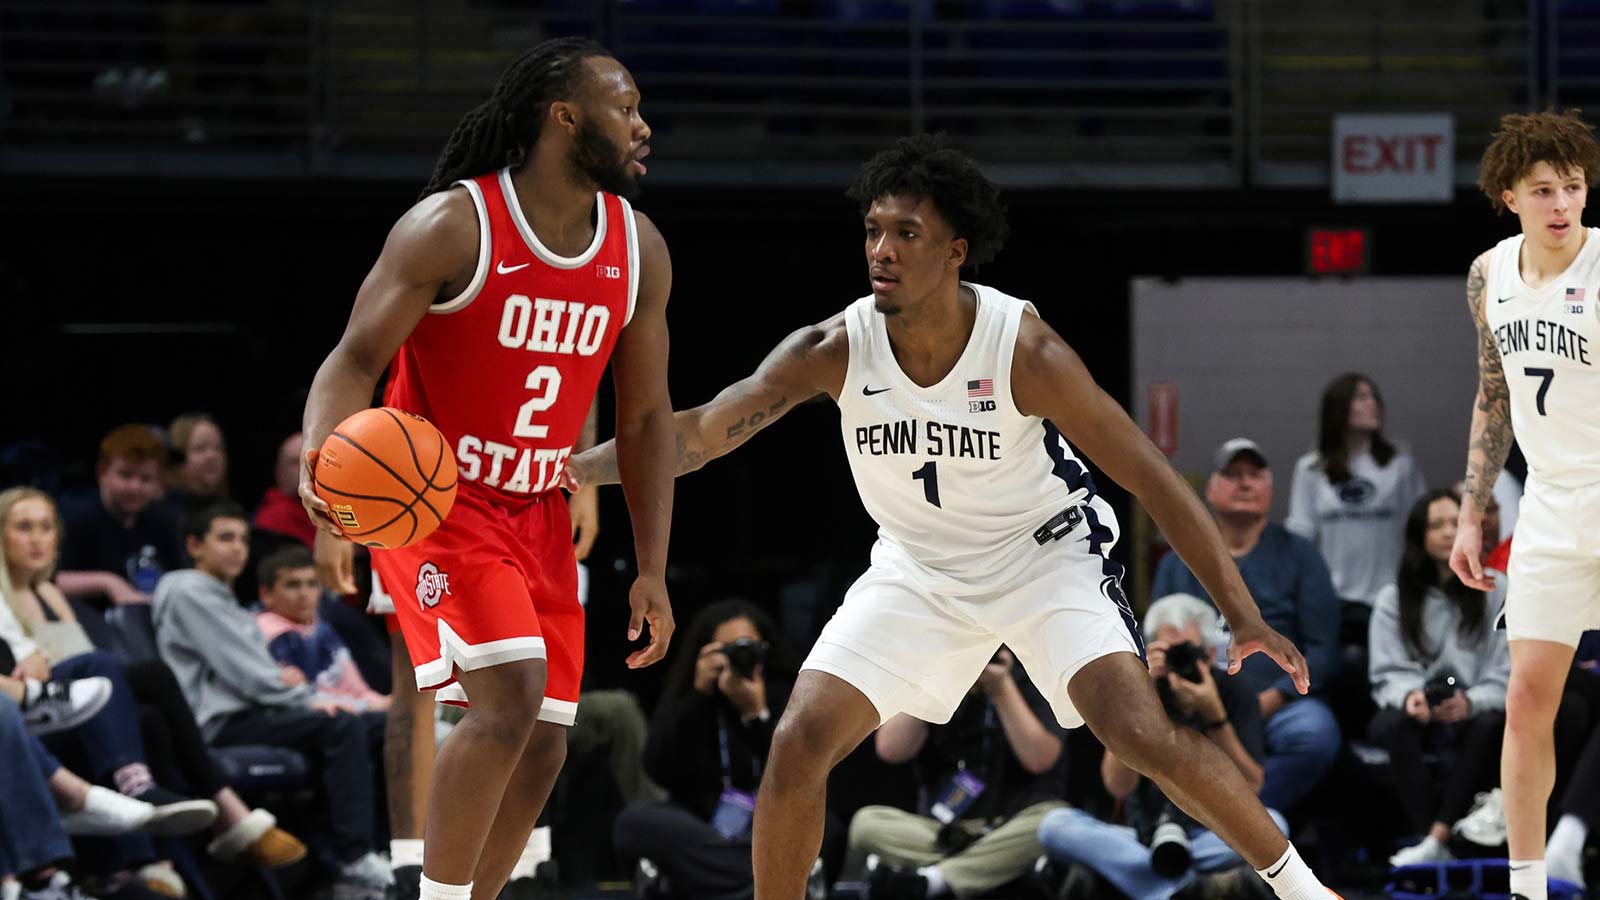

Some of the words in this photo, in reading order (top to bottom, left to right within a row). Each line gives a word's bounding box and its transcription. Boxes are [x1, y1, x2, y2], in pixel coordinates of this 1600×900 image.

[1343, 134, 1442, 174] EXIT
[497, 293, 611, 356] OHIO
[1536, 319, 1592, 366] STATE
[512, 365, 562, 438] 2
[1523, 366, 1555, 416] 7
[456, 434, 573, 494] STATE
[855, 419, 917, 456] PENN
[926, 420, 1002, 460] STATE
[911, 460, 942, 509] 1
[425, 573, 452, 596] STATE
